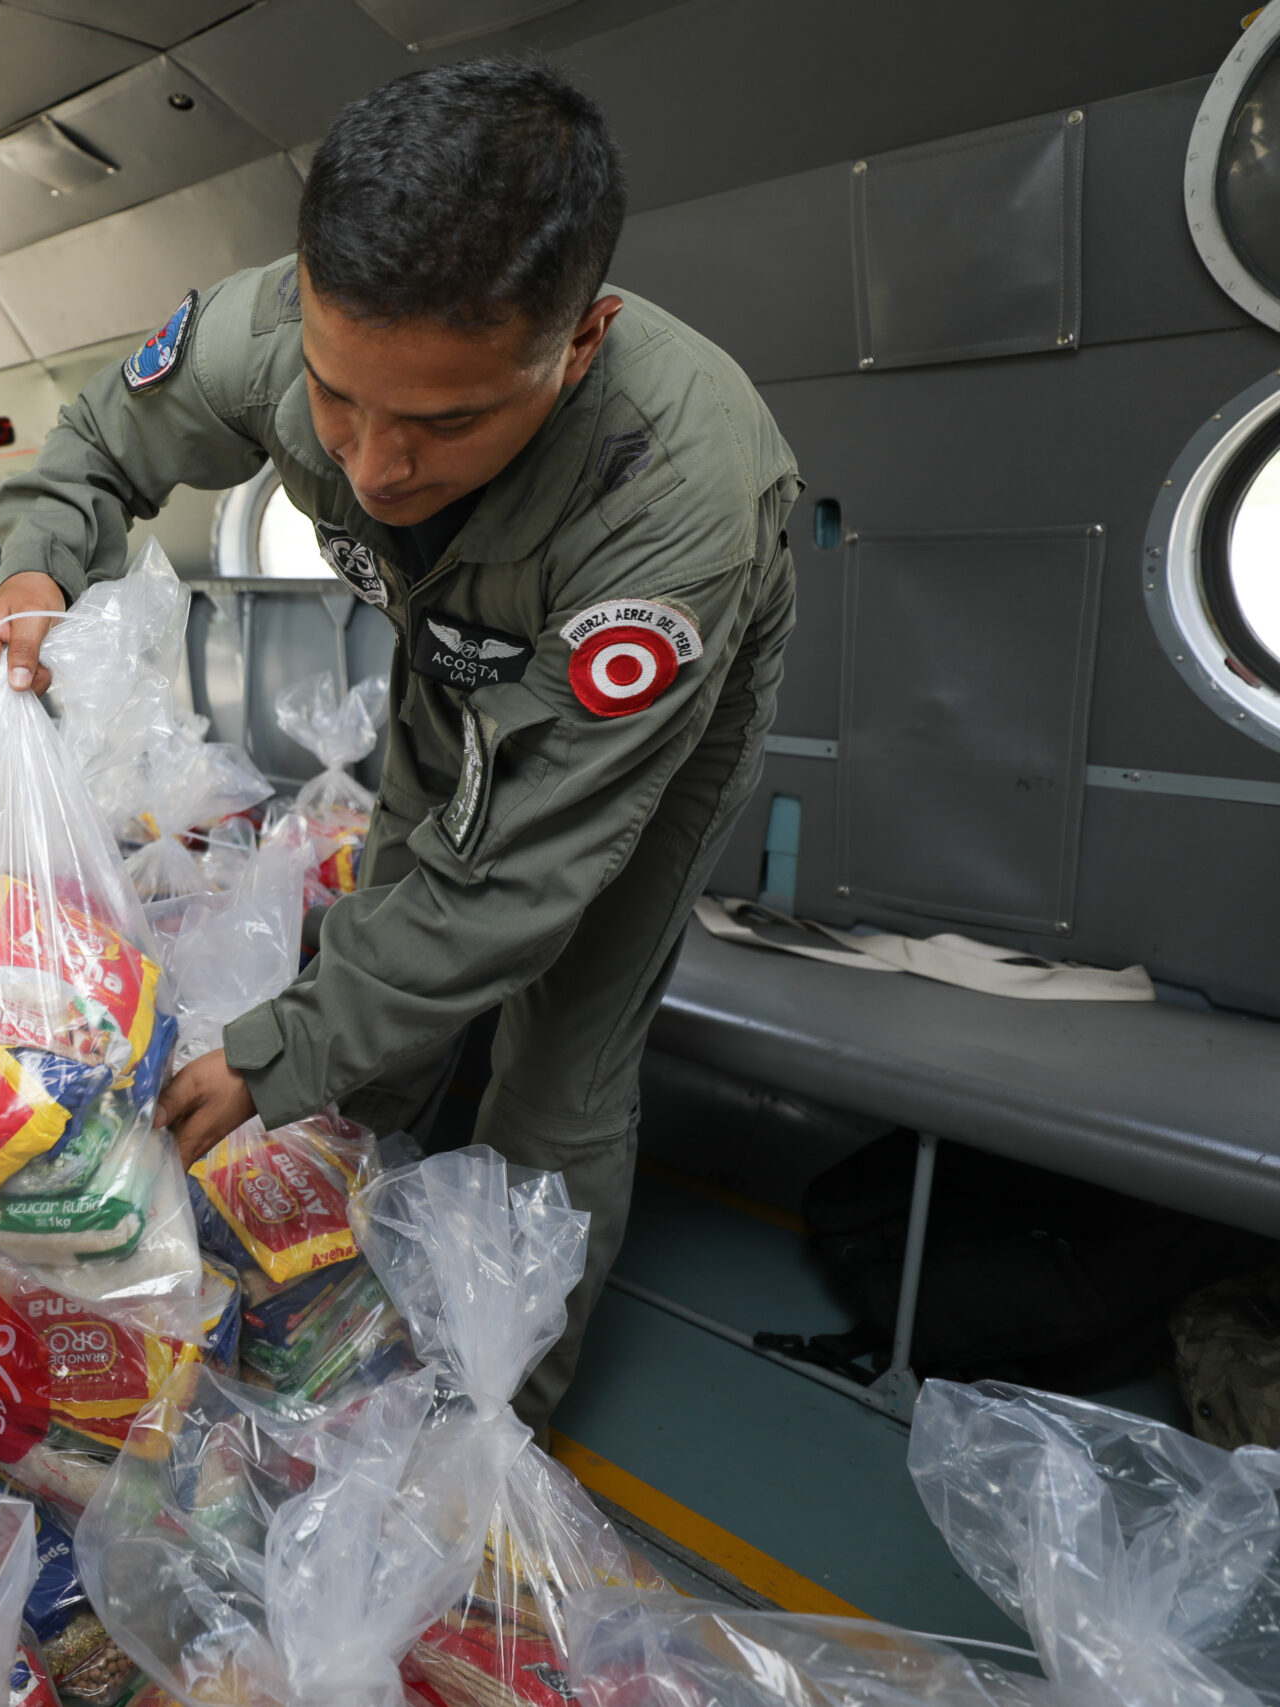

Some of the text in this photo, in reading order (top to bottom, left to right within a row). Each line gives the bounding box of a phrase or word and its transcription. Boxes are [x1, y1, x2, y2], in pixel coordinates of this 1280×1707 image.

[569, 608, 694, 657] FUERZA AEREA DEL PERU
[431, 651, 499, 682] ACOSTA
[450, 670, 476, 687] (A+)
[254, 1175, 291, 1214] ORO
[271, 1153, 330, 1216] Avena
[47, 1218, 71, 1229] 1kg
[311, 1246, 352, 1269] Avena
[28, 1297, 92, 1318] ena
[44, 1325, 108, 1354] ORO
[67, 1352, 109, 1365] GRANO
